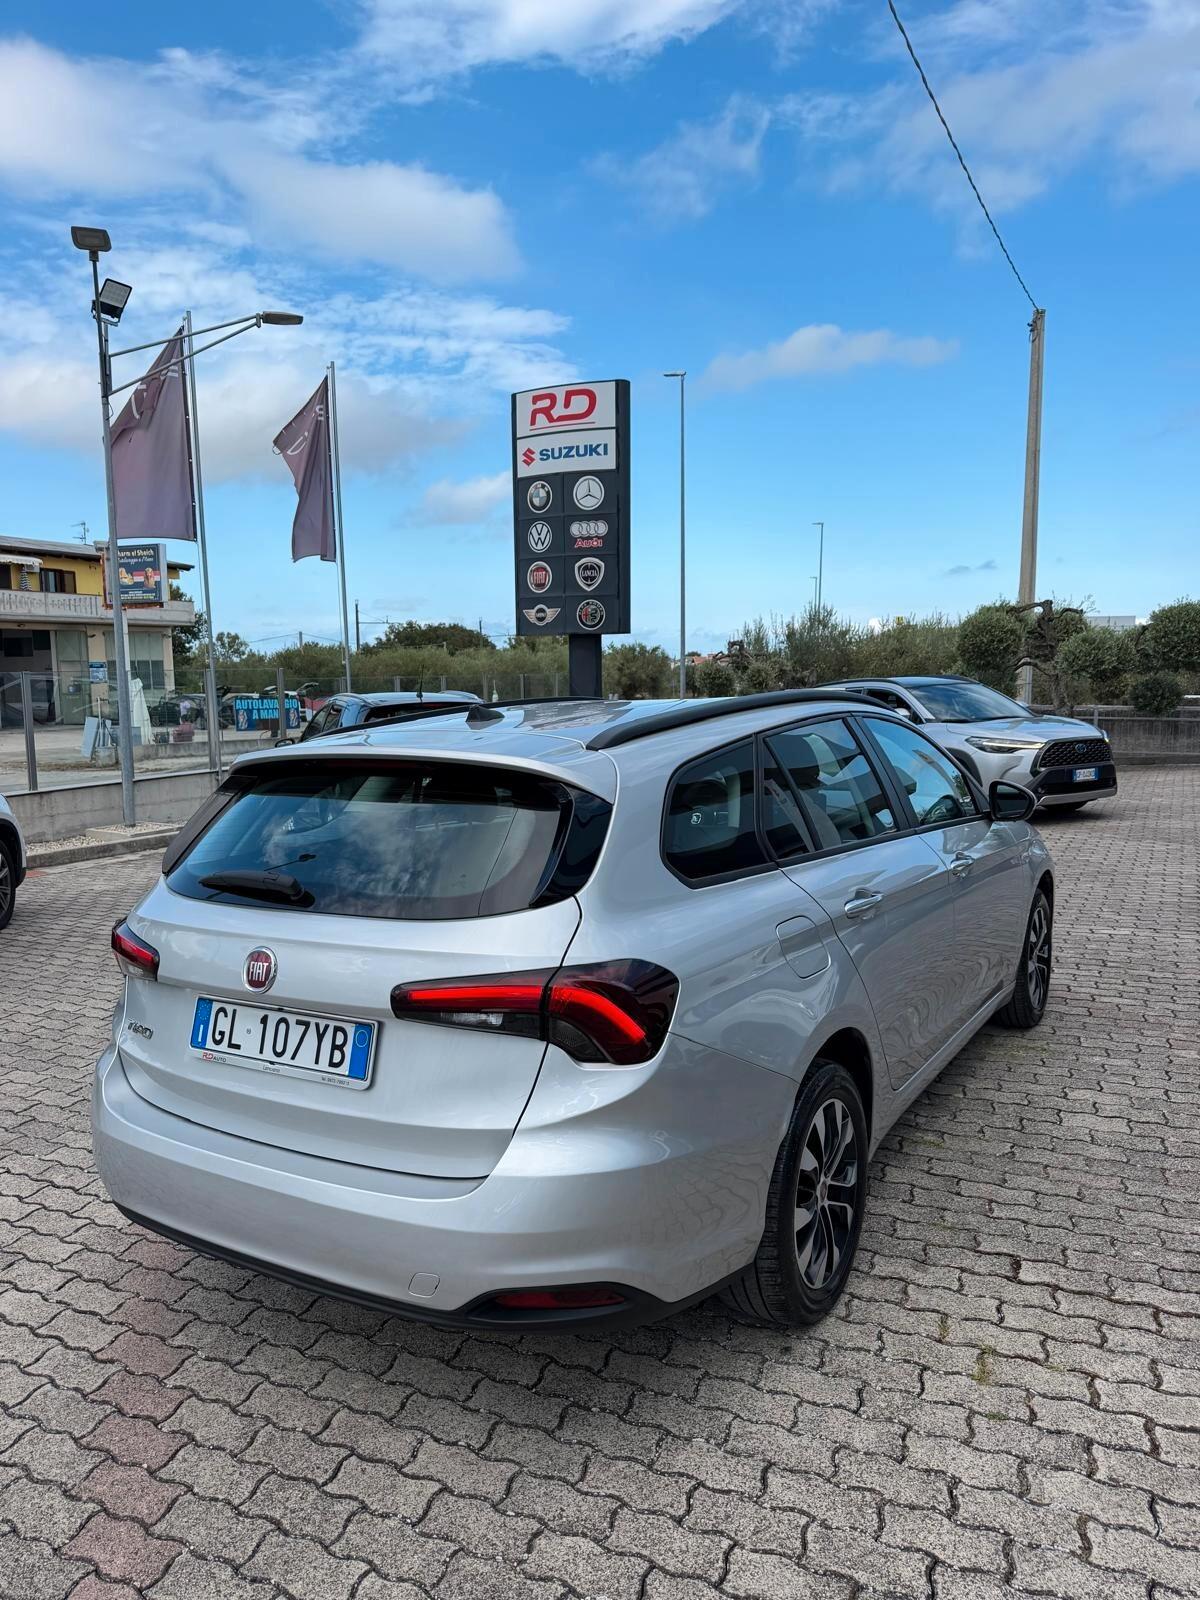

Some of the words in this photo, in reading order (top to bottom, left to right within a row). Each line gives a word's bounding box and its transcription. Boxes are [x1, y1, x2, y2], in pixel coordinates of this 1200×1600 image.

[530, 388, 597, 426] RD
[539, 443, 608, 461] SUZUKI
[574, 538, 603, 548] Audi
[533, 571, 546, 584] FIAT
[236, 699, 297, 709] AUTOLAVAGIO
[253, 710, 259, 719] A
[261, 709, 279, 719] MAN
[249, 961, 269, 982] FIAT
[211, 1006, 242, 1051] GL
[259, 1014, 349, 1068] 107YB
